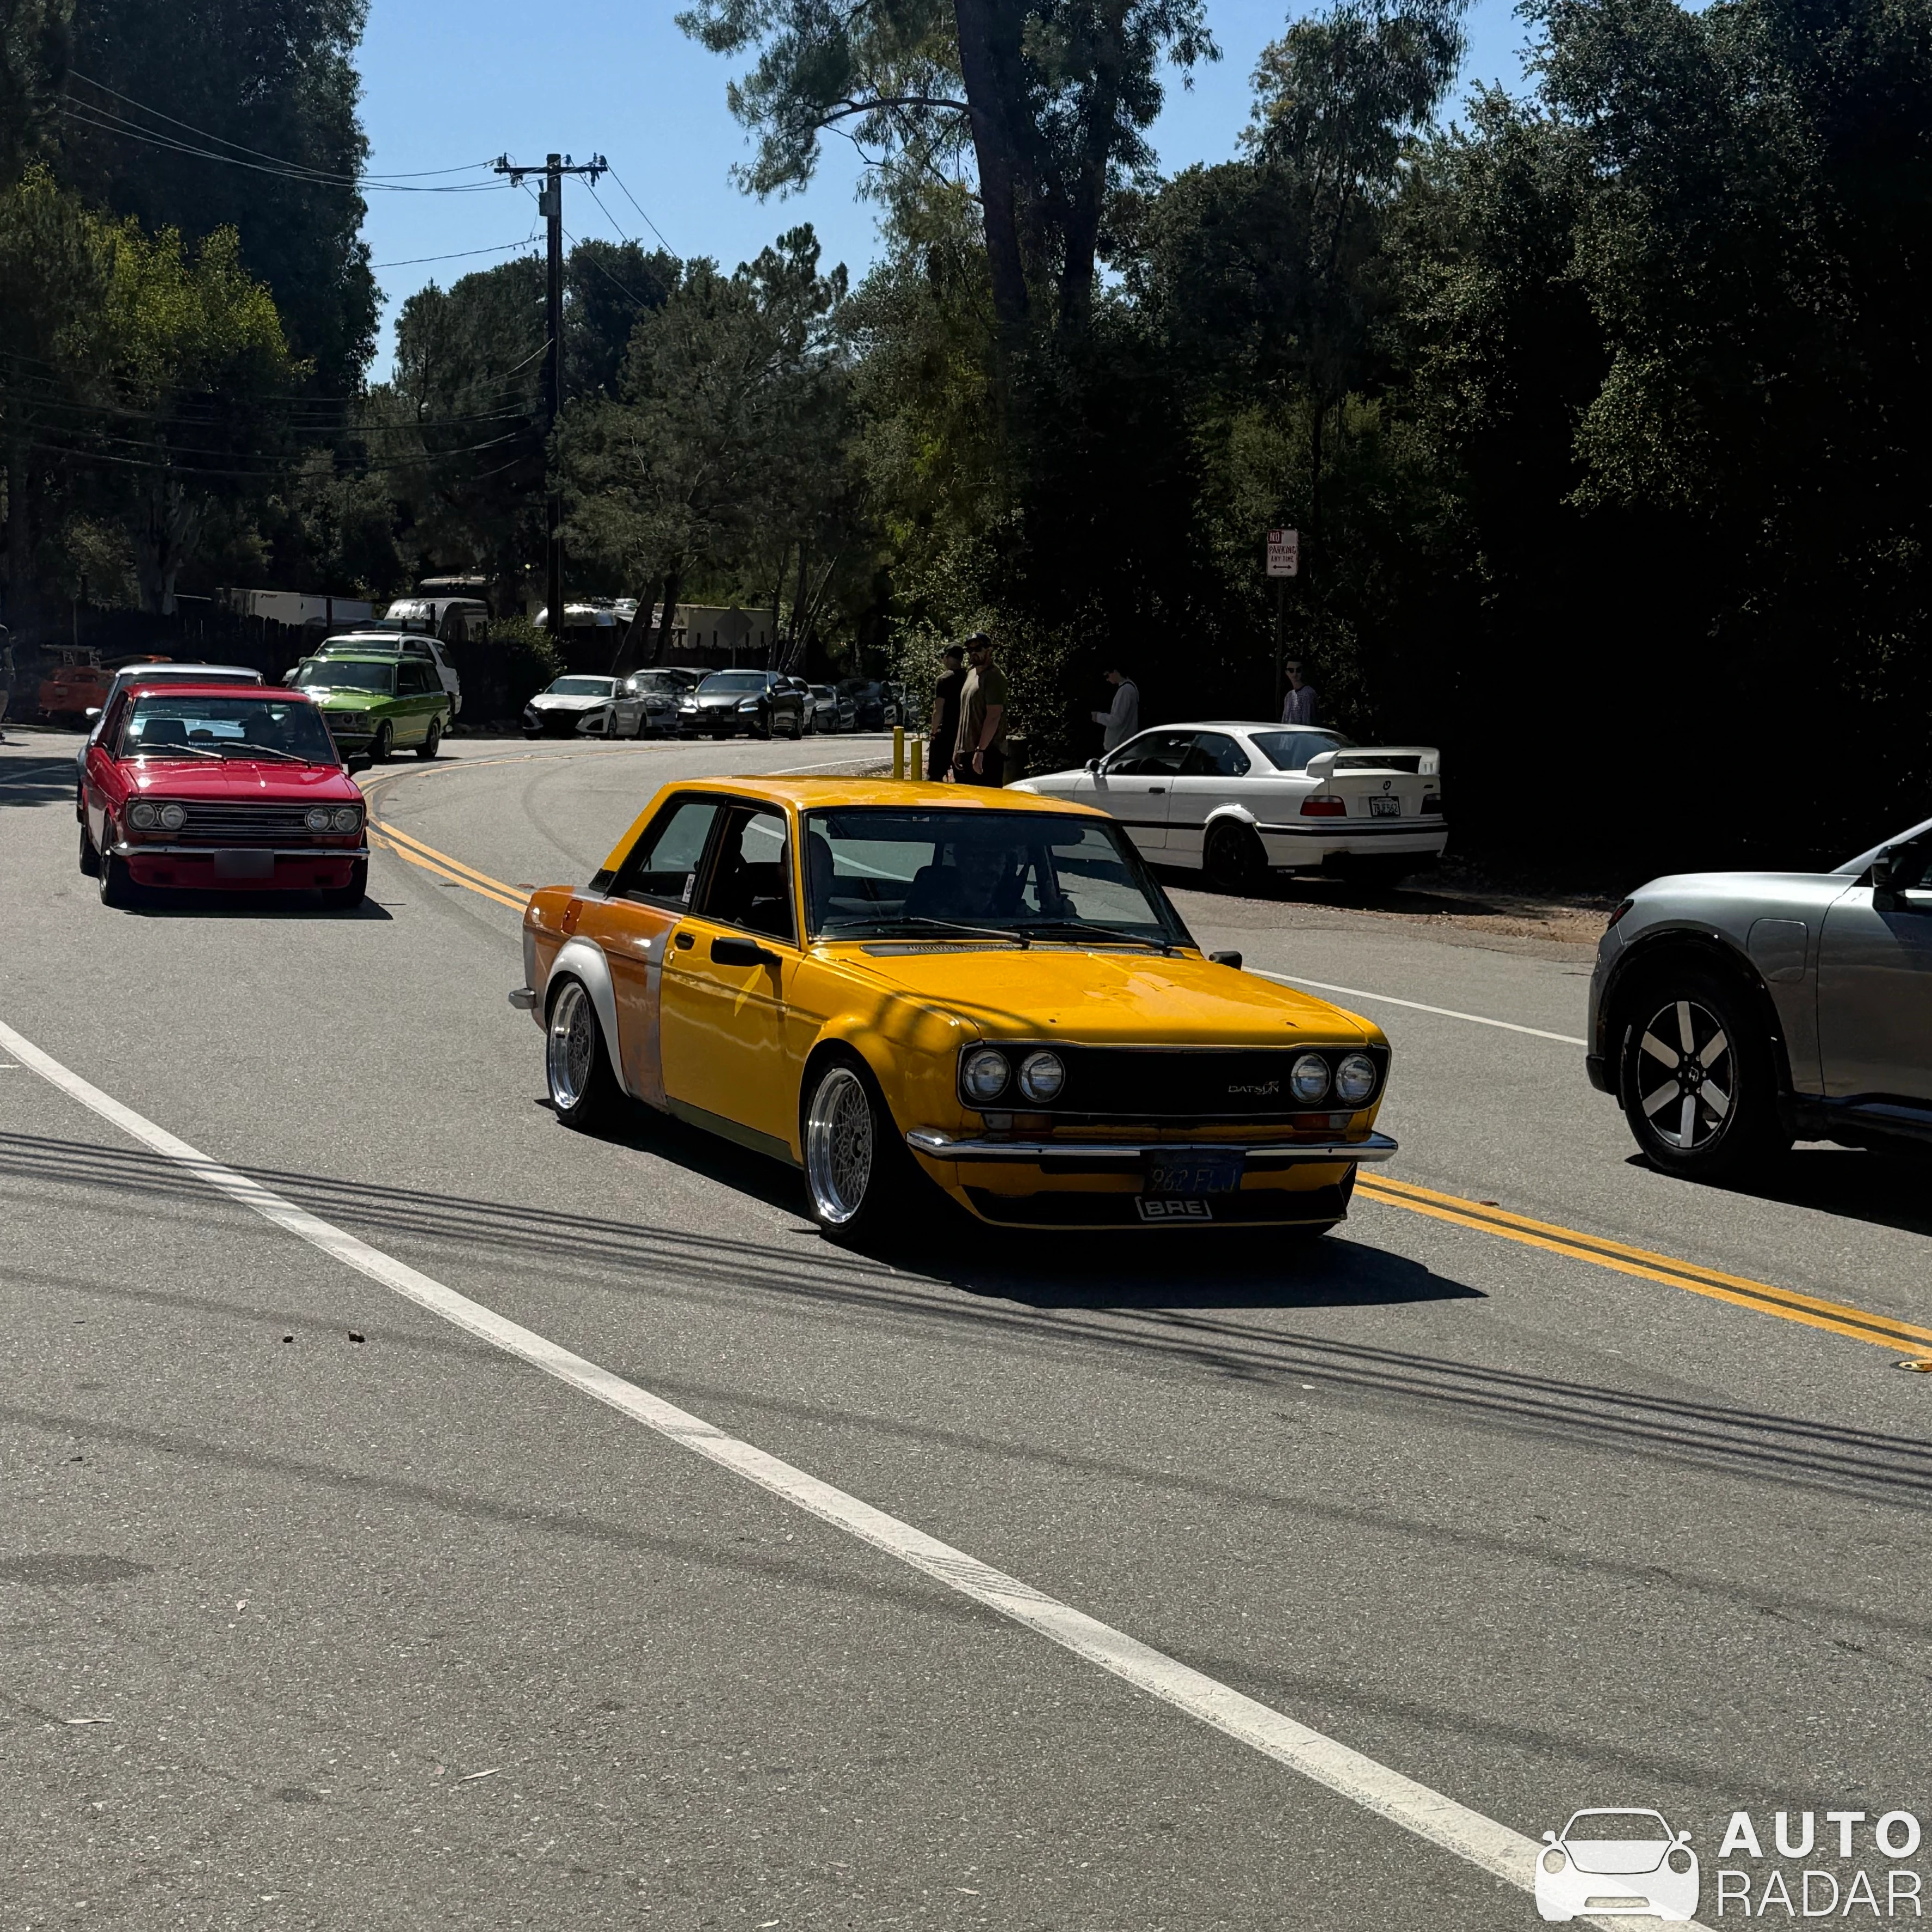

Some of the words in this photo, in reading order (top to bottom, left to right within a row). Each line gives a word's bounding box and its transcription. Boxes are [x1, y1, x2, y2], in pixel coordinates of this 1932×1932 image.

[1269, 532, 1280, 542] NO
[1269, 545, 1296, 554] PARKING
[1144, 1200, 1203, 1215] BRE
